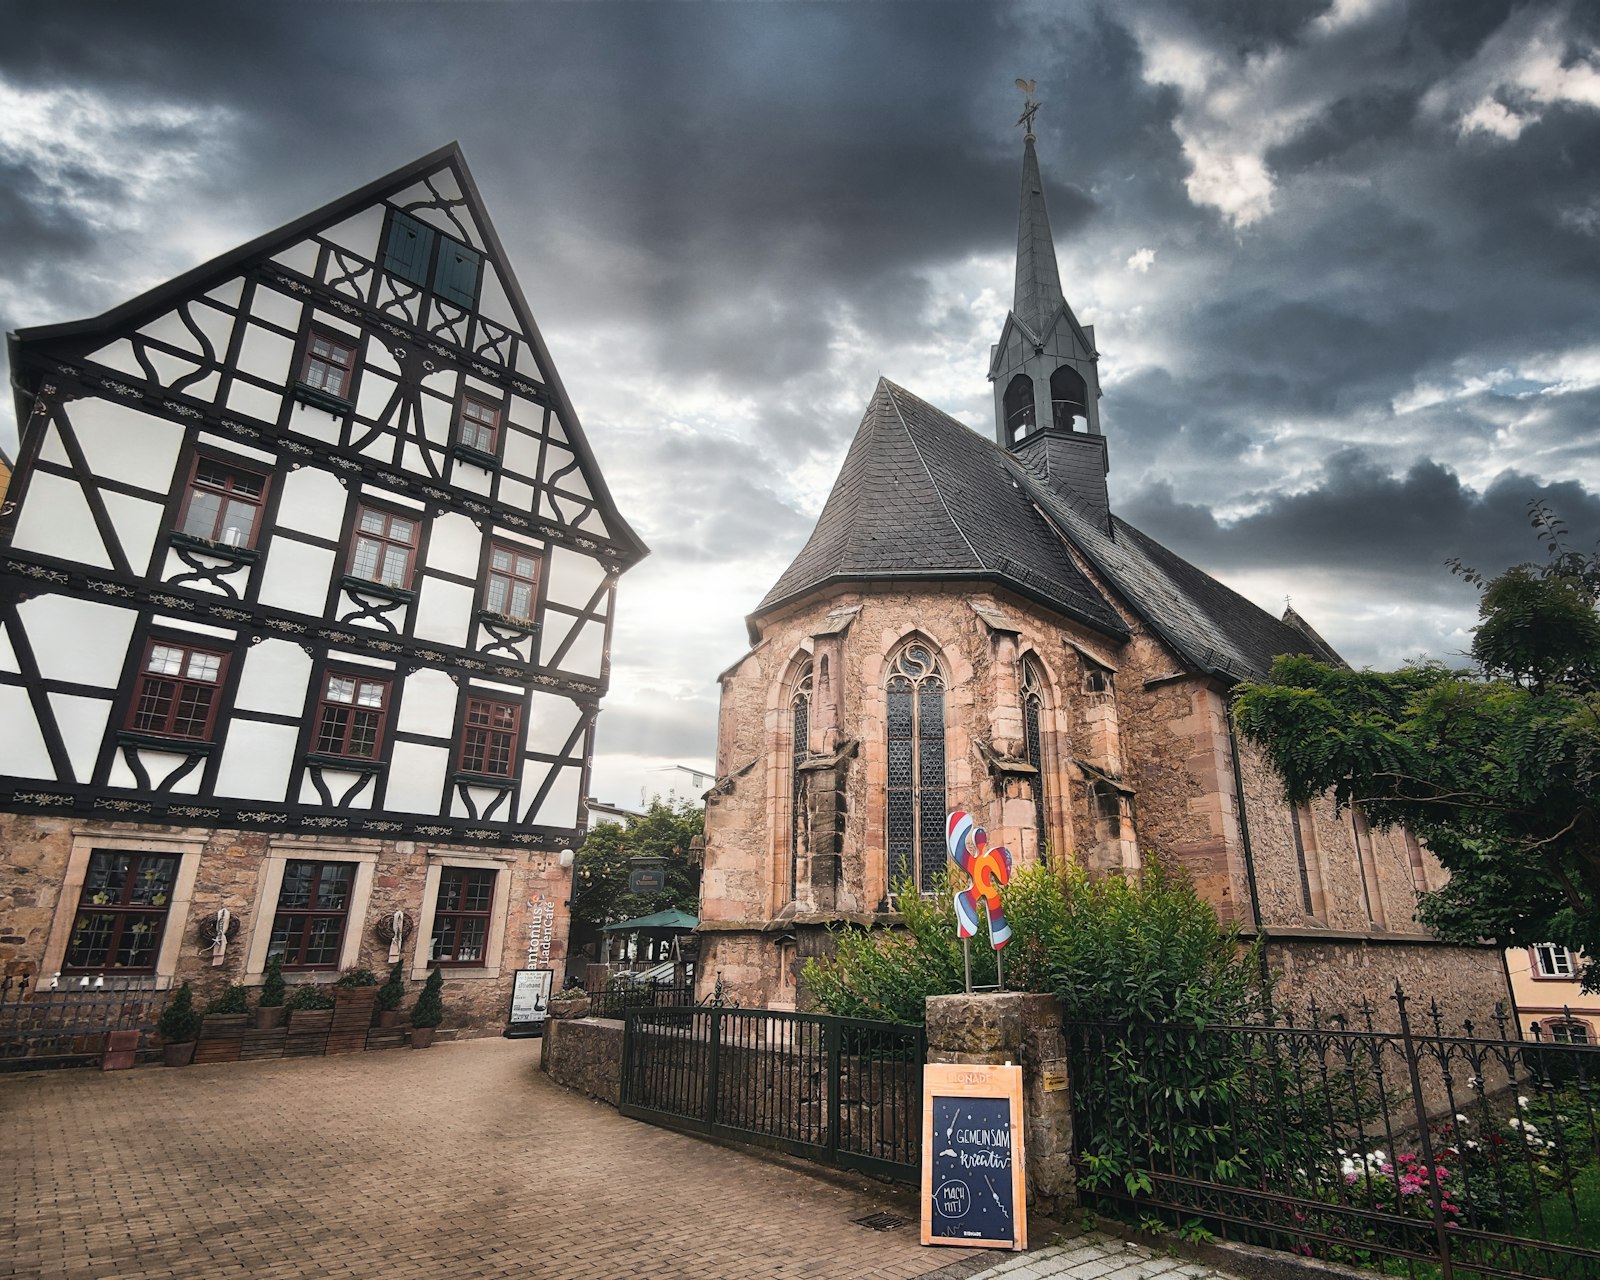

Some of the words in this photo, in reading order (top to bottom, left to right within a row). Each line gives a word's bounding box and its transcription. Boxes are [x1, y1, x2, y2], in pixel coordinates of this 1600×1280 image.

[528, 908, 543, 970] antonius
[539, 901, 555, 965] LadenCafé
[956, 1129, 1010, 1149] GEMEINSAM
[960, 1150, 1011, 1169] kreativ
[943, 1187, 965, 1200] MACH
